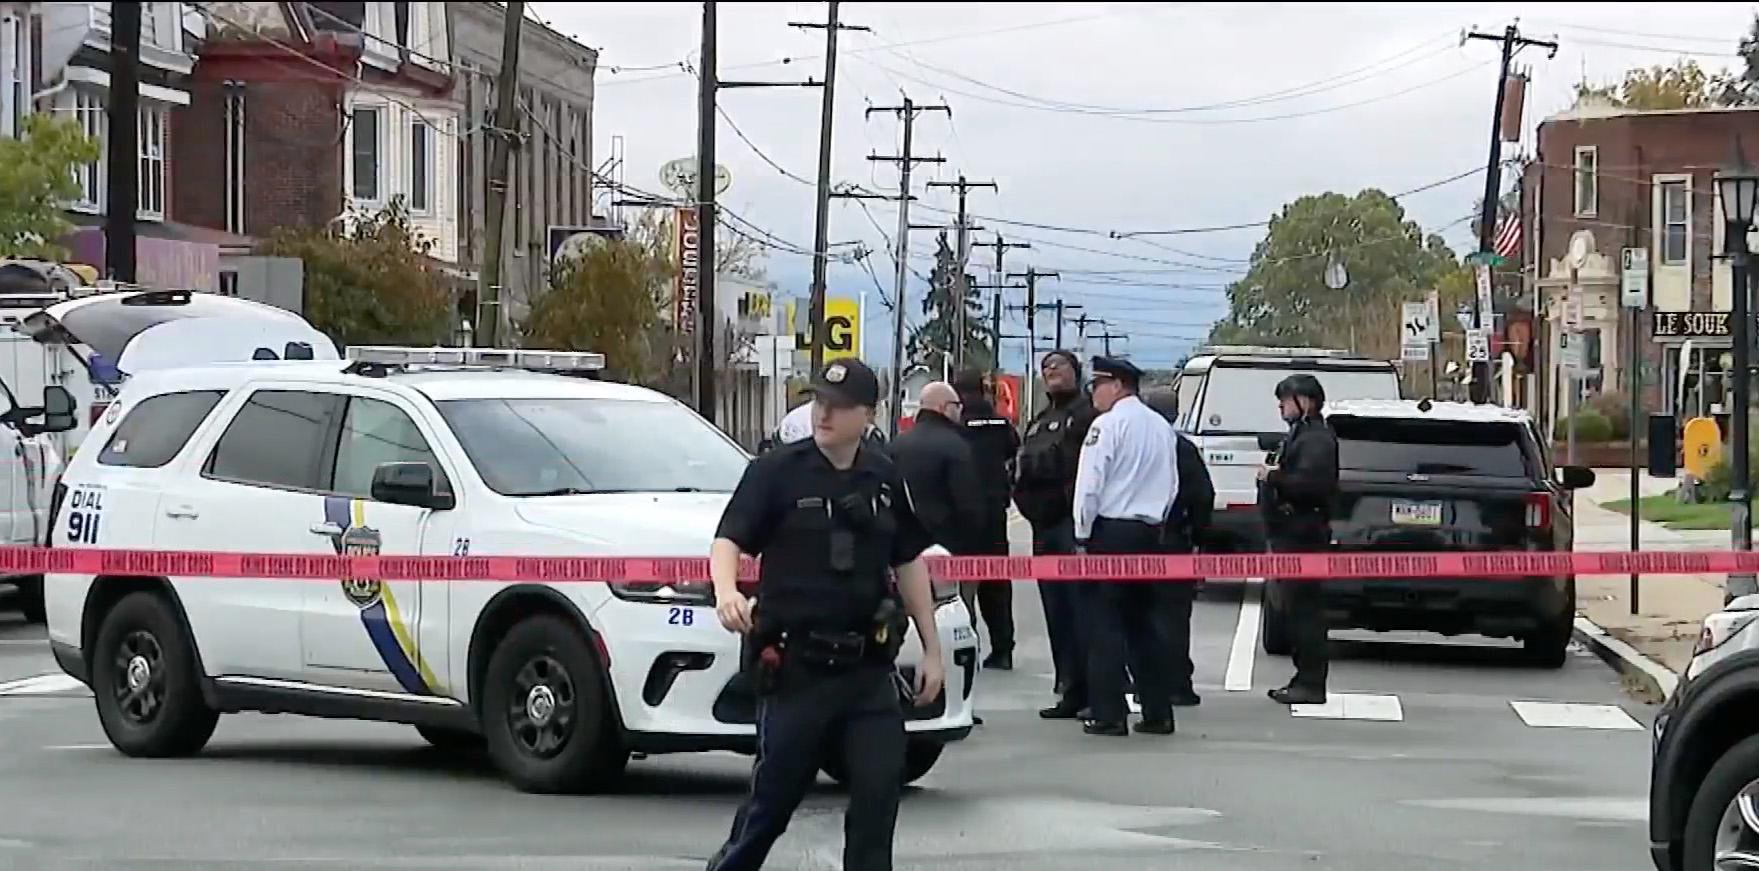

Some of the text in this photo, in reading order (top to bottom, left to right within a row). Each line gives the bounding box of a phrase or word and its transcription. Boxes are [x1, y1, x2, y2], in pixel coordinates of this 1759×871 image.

[1655, 313, 1729, 335] LE SOUK
[1469, 345, 1487, 359] 25
[71, 490, 102, 510] DIAL
[67, 512, 100, 544] 911
[16, 551, 28, 569] DO
[30, 551, 45, 569] NOT
[48, 551, 74, 570] CROSS
[129, 552, 154, 571] SCENE
[156, 553, 168, 572] DO
[170, 553, 185, 573] NOT
[188, 553, 214, 573] CROSS
[268, 557, 293, 574] SCENE
[296, 557, 306, 574] DO
[309, 557, 323, 575] NOT
[326, 557, 353, 575] CROSS
[406, 559, 431, 576] SCENE
[433, 559, 444, 576] DO
[446, 559, 461, 576] NOT
[464, 559, 489, 576] CROSS
[543, 559, 568, 577] SCENE
[570, 559, 581, 577] DO
[583, 559, 598, 577] NOT
[600, 559, 626, 577] CROSS
[678, 559, 704, 577] SCENE
[949, 559, 974, 576] SCENE
[977, 558, 987, 576] DO
[989, 558, 1004, 576] NOT
[1006, 558, 1032, 576] CROSS
[1084, 558, 1109, 575] SCENE
[1111, 558, 1122, 575] DO
[1124, 557, 1138, 575] NOT
[1141, 557, 1166, 575] CROSS
[1219, 557, 1244, 575] SCENE
[1246, 557, 1257, 575] DO
[1259, 556, 1273, 575] NOT
[1276, 556, 1301, 575] CROSS
[1354, 556, 1379, 573] SCENE
[1381, 556, 1392, 573] DO
[1394, 556, 1408, 573] NOT
[1411, 556, 1437, 573] CROSS
[1489, 555, 1514, 572] SCENE
[1516, 555, 1527, 572] DO
[1529, 555, 1544, 571] NOT
[1546, 555, 1573, 571] CROSS
[1626, 553, 1651, 571] SCENE
[1653, 554, 1663, 571] DO
[1665, 553, 1680, 570] NOT
[1683, 553, 1710, 571] CROSS
[668, 608, 694, 625] 2B
